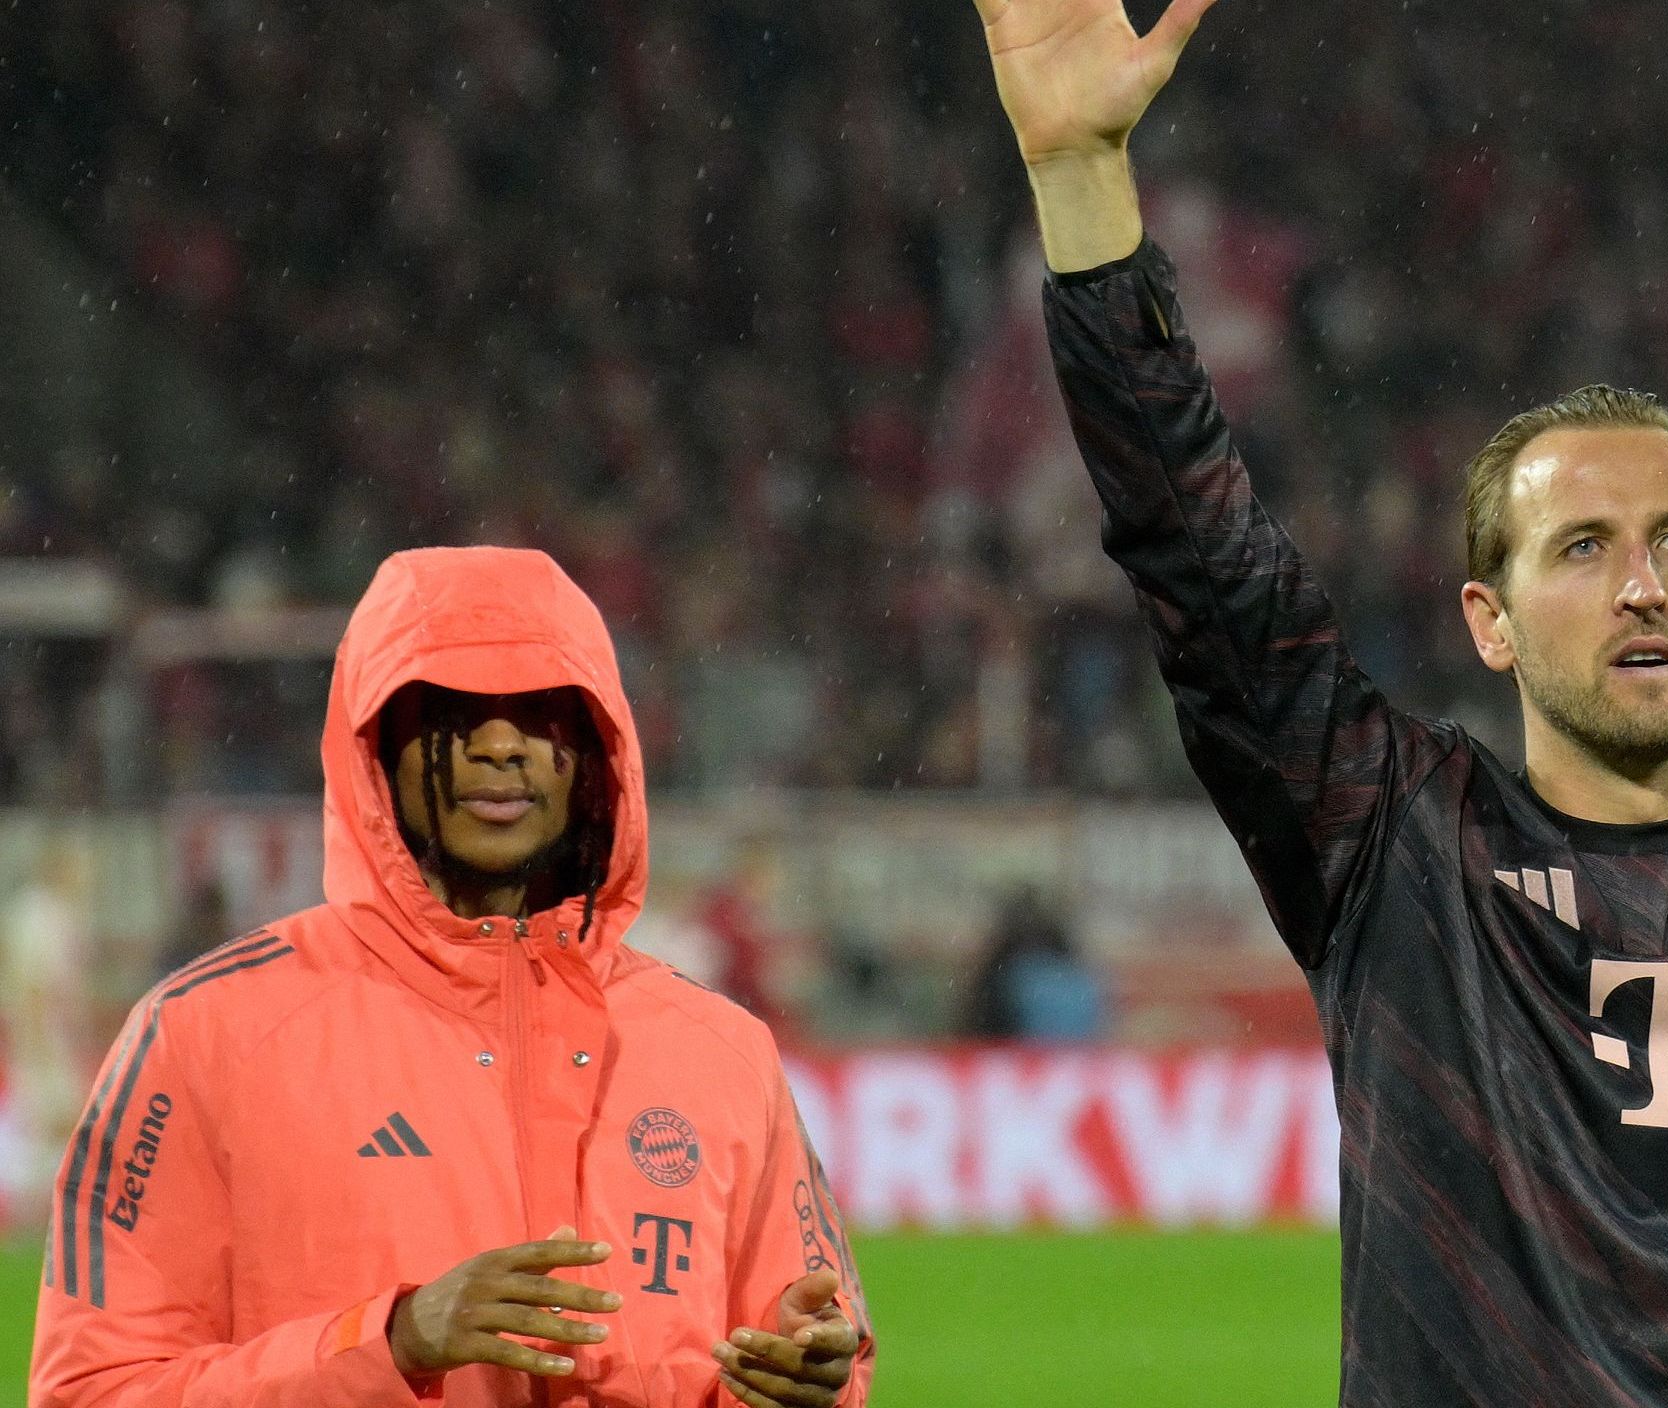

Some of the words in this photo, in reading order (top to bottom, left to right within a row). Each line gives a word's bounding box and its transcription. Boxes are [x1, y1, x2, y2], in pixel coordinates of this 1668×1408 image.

[110, 1093, 172, 1232] Betano
[647, 1112, 698, 1146] BAYERN
[632, 1212, 693, 1296] T
